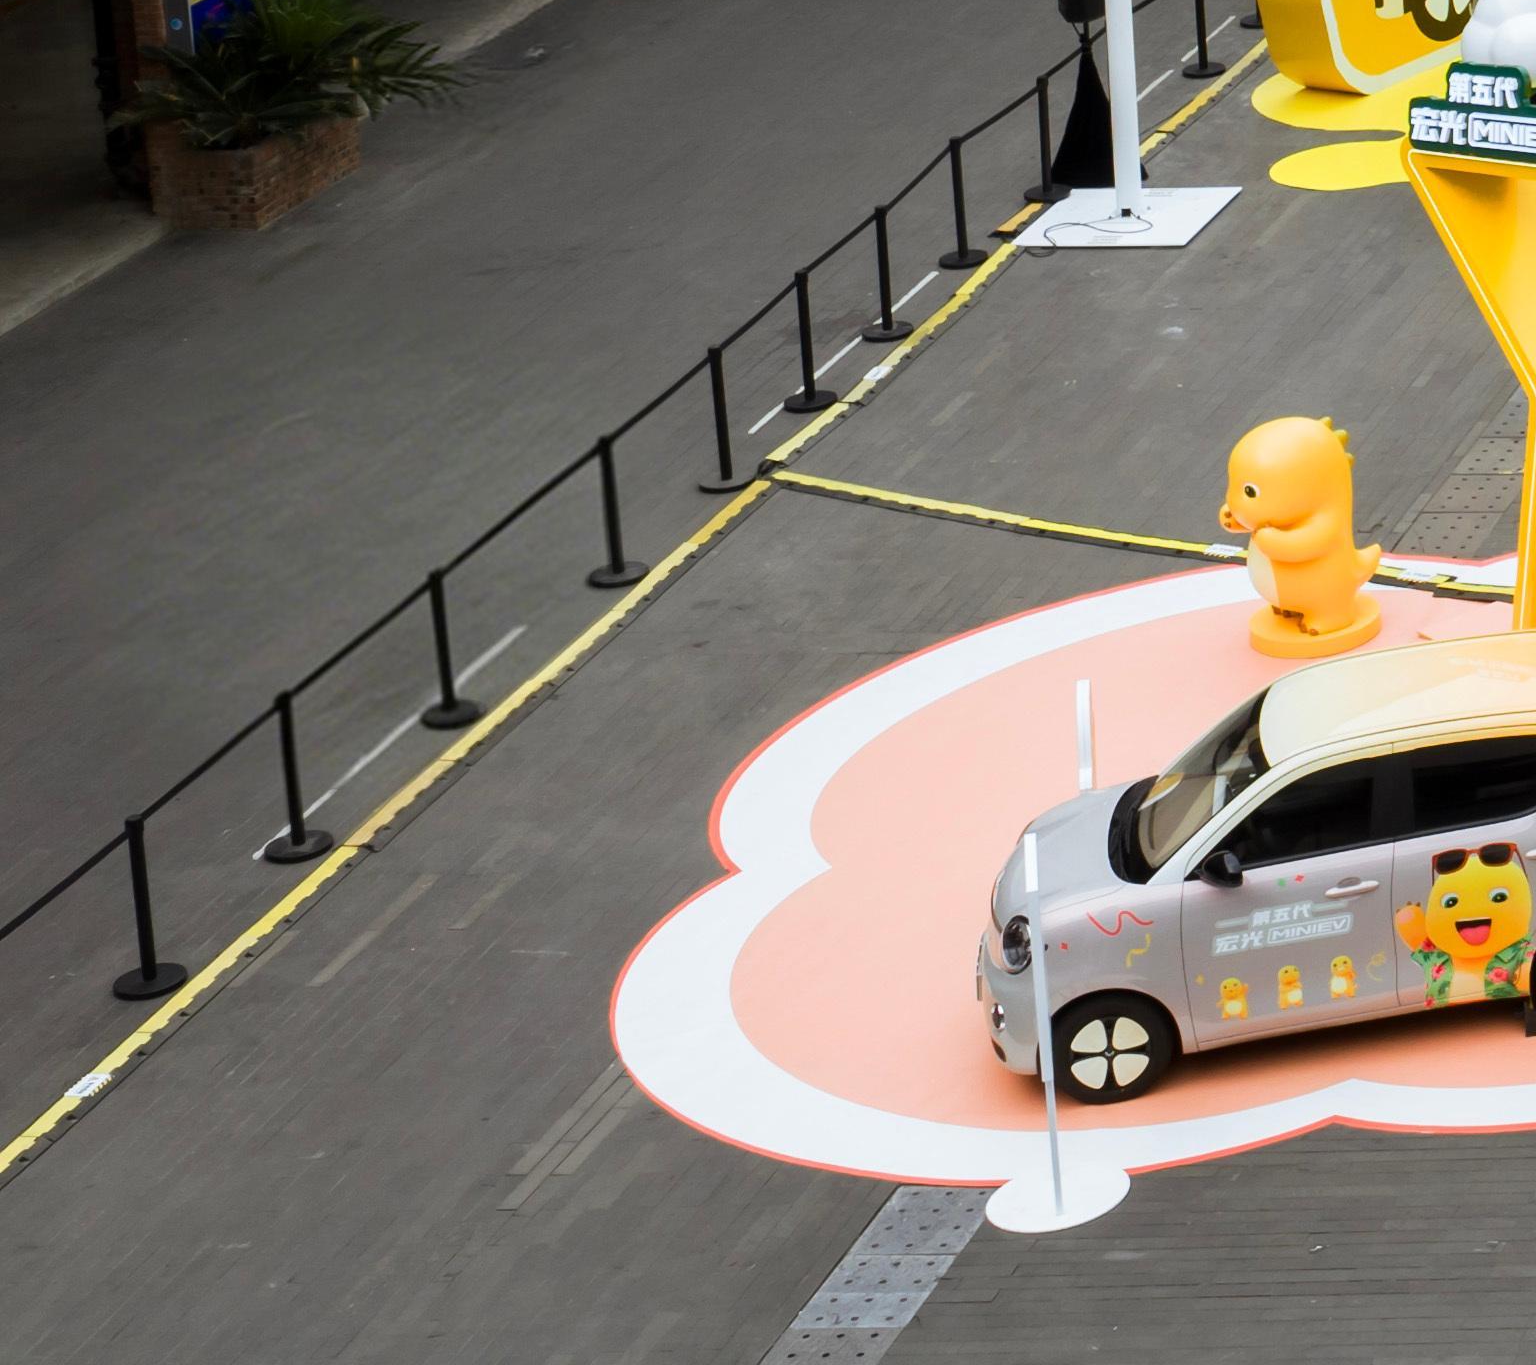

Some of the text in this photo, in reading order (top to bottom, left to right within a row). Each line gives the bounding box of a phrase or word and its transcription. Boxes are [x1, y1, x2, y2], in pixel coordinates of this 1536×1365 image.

[1449, 72, 1518, 109] 第五代
[1411, 107, 1467, 145] 宏光
[1252, 904, 1311, 926] 第五代
[1215, 918, 1346, 953] 宏光 MINIEV
